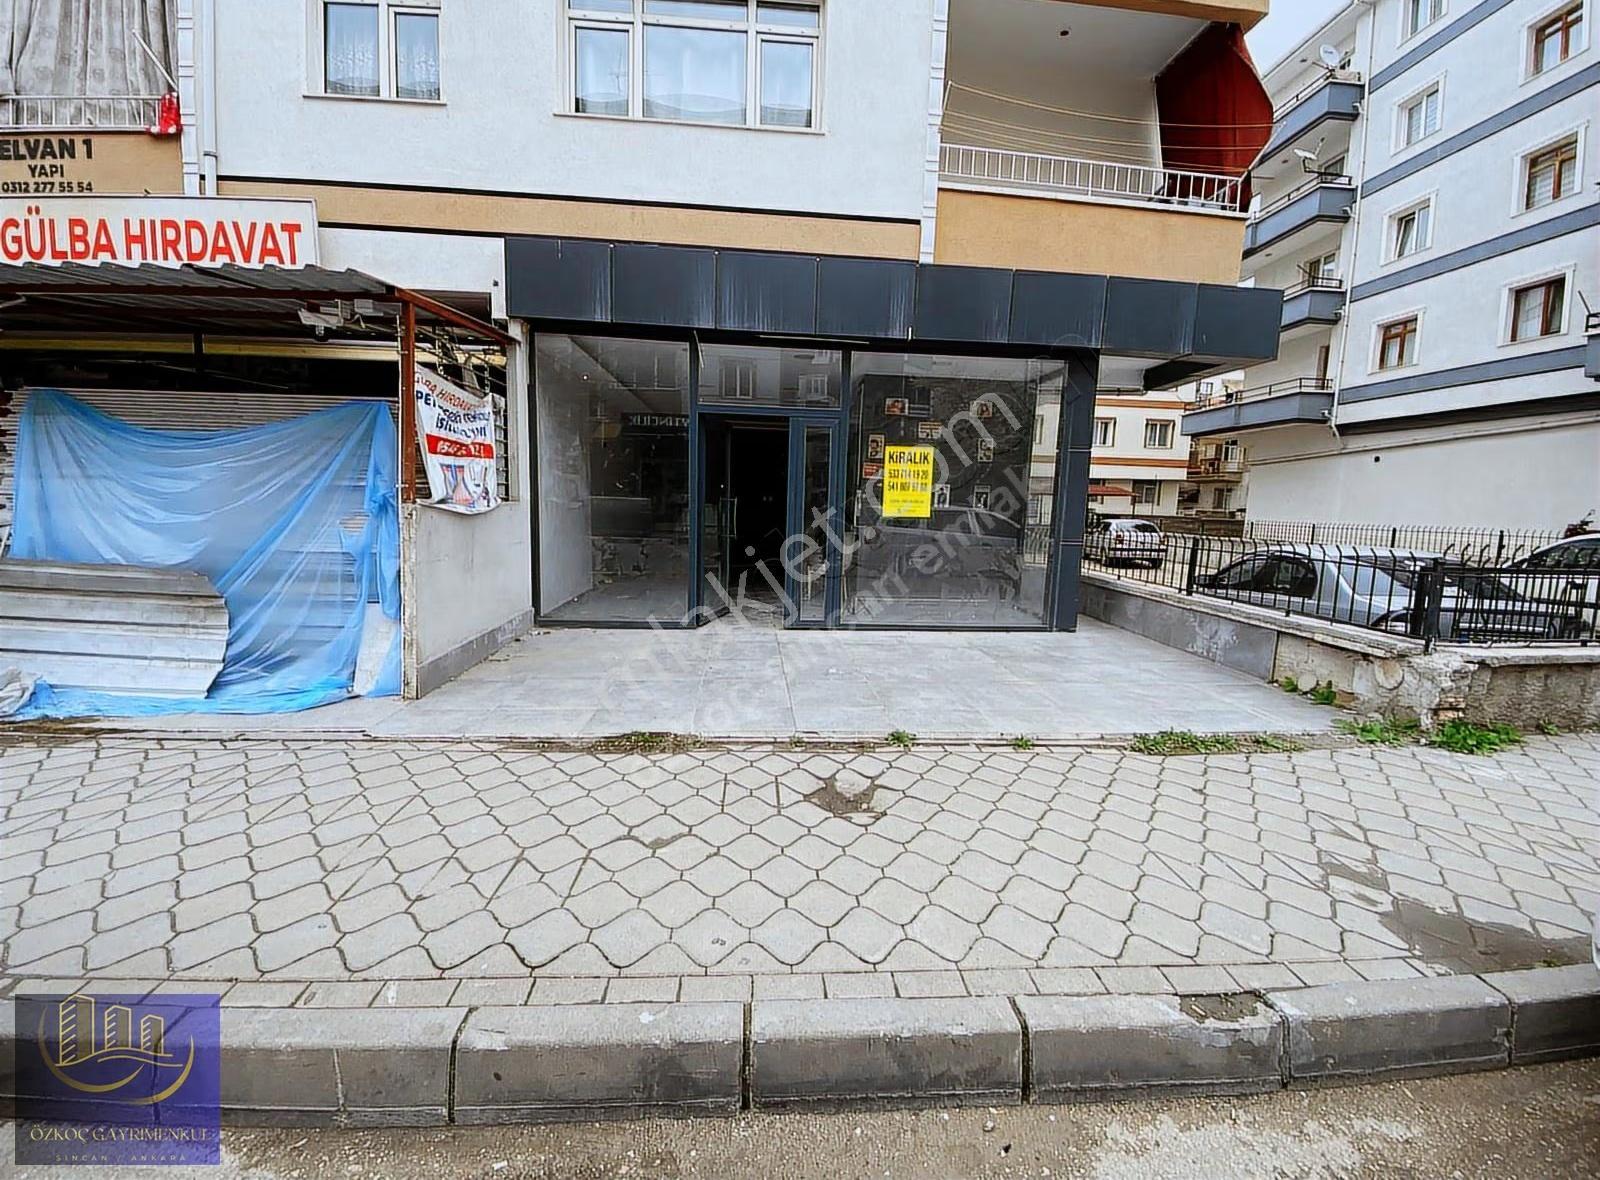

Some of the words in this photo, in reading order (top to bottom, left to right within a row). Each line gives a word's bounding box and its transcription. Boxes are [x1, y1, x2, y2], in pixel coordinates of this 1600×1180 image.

[0, 138, 76, 160] ELVAN
[83, 138, 93, 159] 1
[27, 164, 64, 178] YAPI
[2, 182, 31, 193] 0312
[34, 182, 55, 193] 277
[59, 182, 74, 193] 55
[77, 182, 93, 193] 54
[1, 205, 118, 261] GÜLBA
[124, 218, 302, 266] HIRDAVAT
